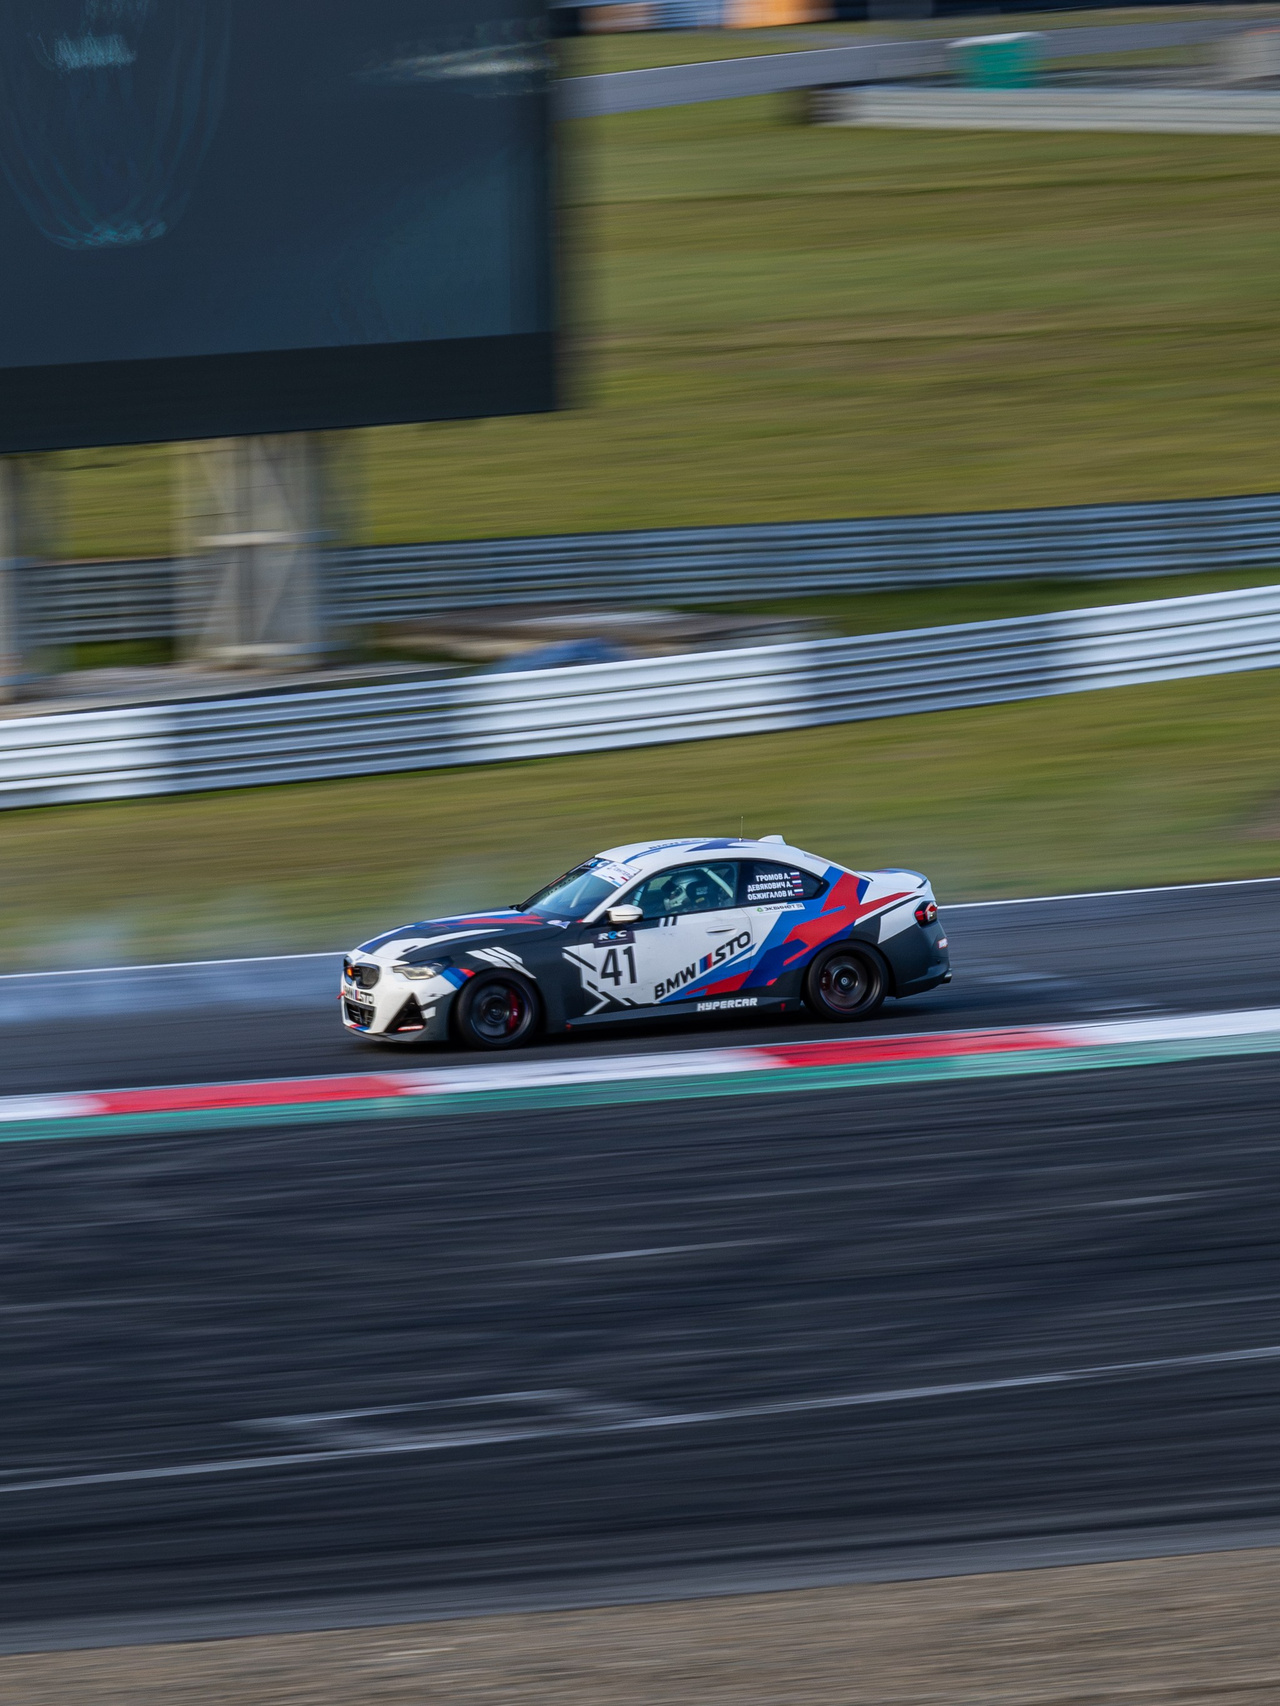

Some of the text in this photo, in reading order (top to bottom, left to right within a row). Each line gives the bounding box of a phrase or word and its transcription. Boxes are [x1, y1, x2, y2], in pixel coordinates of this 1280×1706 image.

[755, 872, 791, 882] ГРОМОВ А.
[747, 881, 785, 893] ДЕВЯКОВИЧ
[747, 889, 795, 901] ОБЖИГАЛОВ И.
[600, 945, 637, 987] 41
[654, 930, 751, 1001] BMW STO
[696, 997, 758, 1012] HYPERCAR
